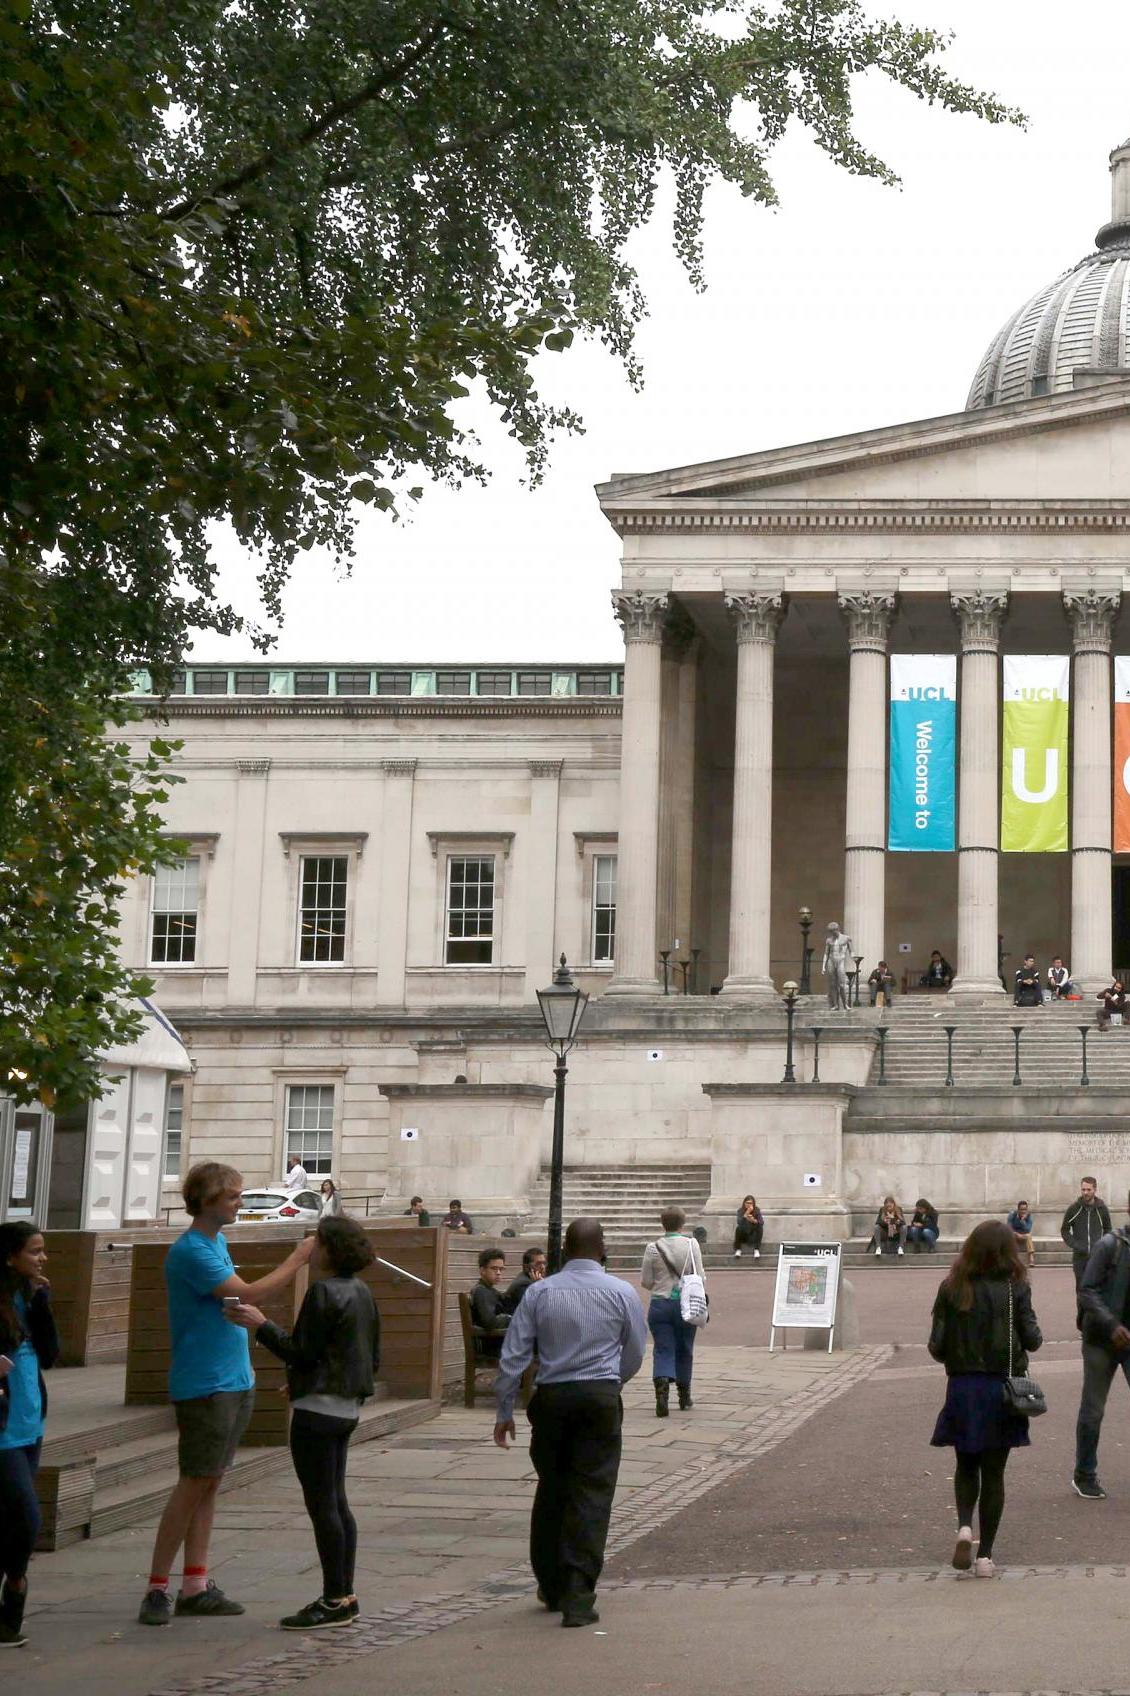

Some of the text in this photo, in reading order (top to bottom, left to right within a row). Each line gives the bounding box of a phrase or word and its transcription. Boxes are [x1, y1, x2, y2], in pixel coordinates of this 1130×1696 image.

[909, 687, 949, 701] UCL
[1022, 688, 1062, 702] UCL
[916, 720, 933, 830] Welcome to
[1012, 748, 1058, 804] U
[817, 1249, 837, 1257] UCL
